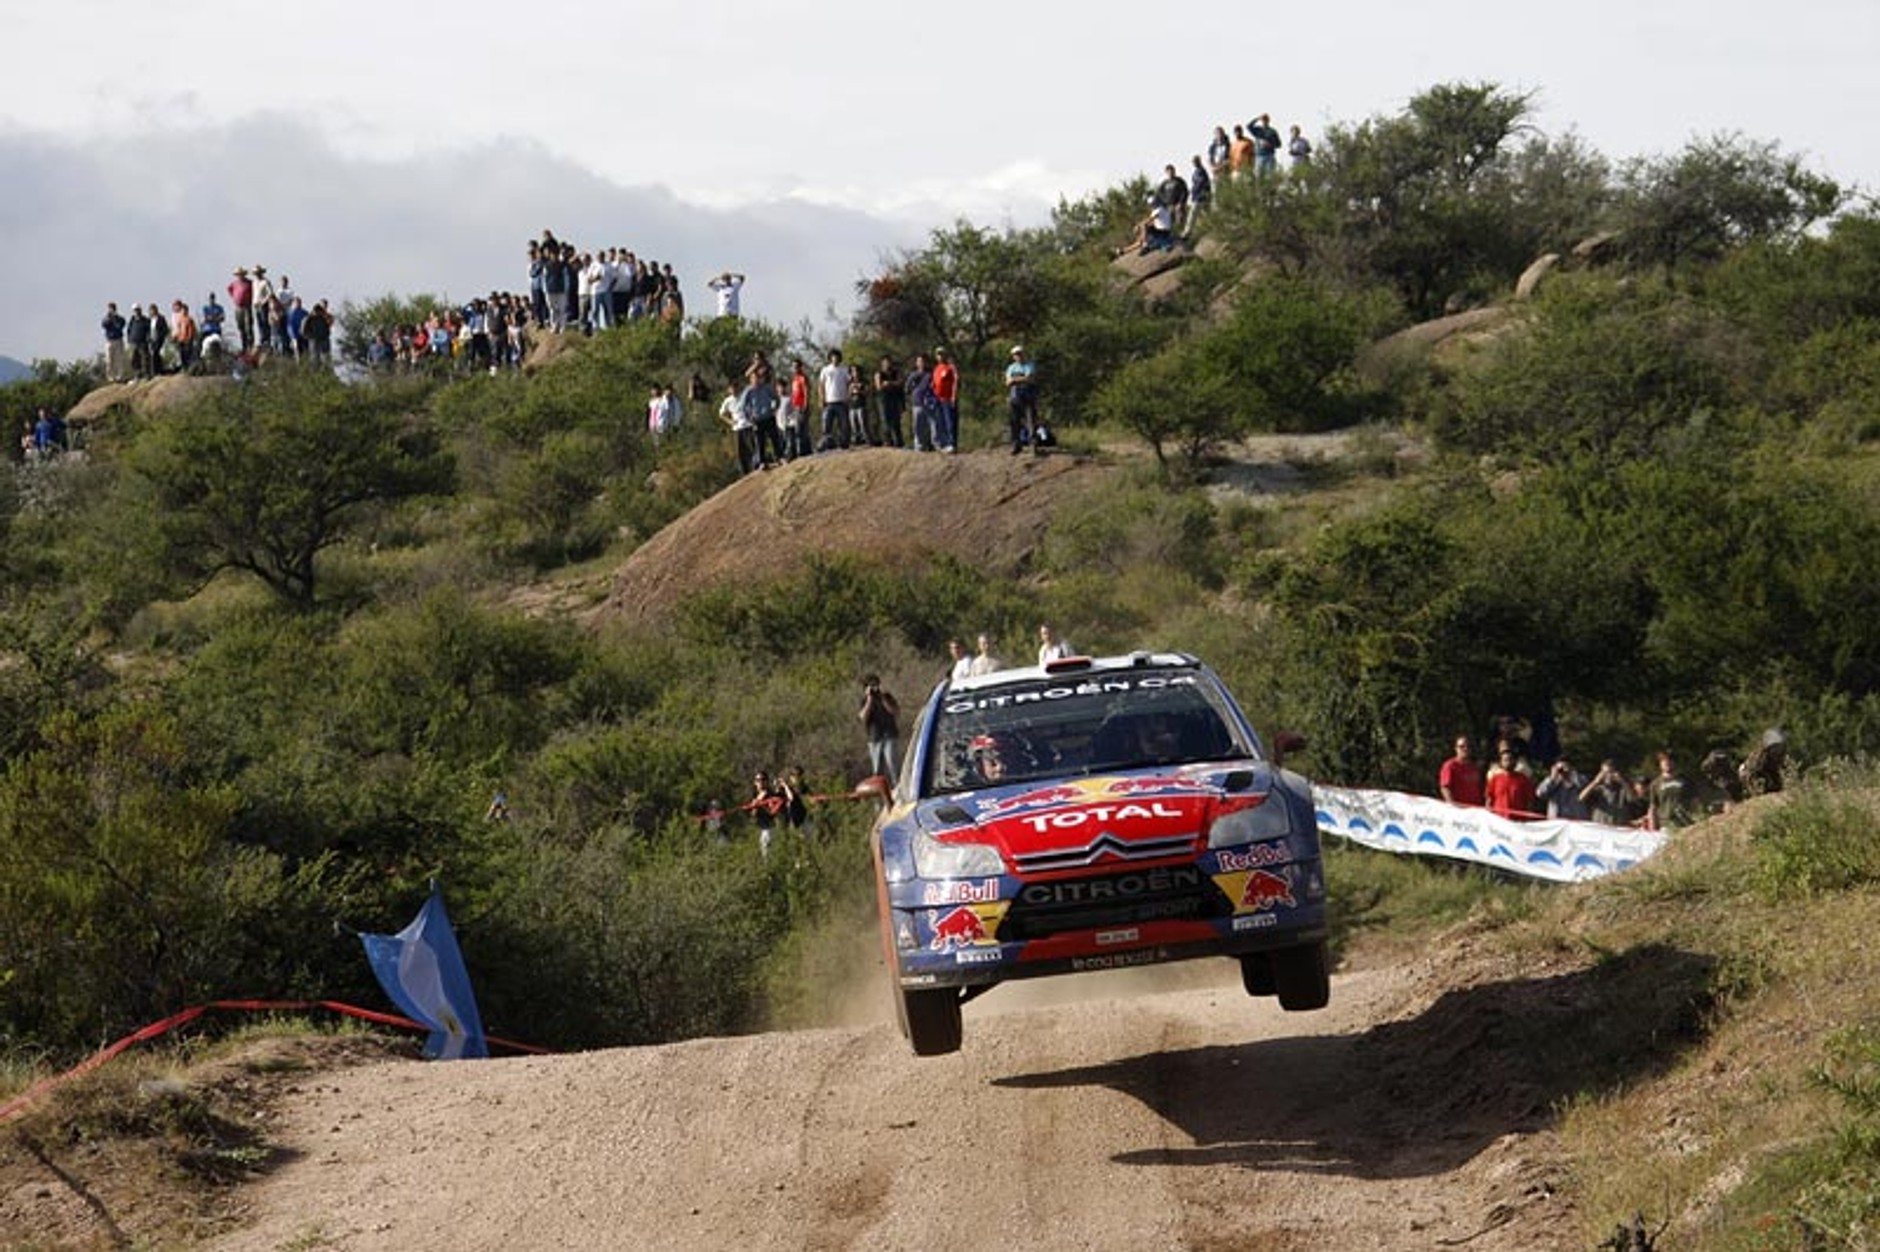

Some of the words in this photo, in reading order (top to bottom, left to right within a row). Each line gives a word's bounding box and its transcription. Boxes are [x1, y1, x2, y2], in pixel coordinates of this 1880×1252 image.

[1021, 803, 1183, 833] TOTAL
[923, 881, 958, 905] Rd
[958, 877, 999, 902] Bull
[1022, 866, 1200, 904] CITROËN
